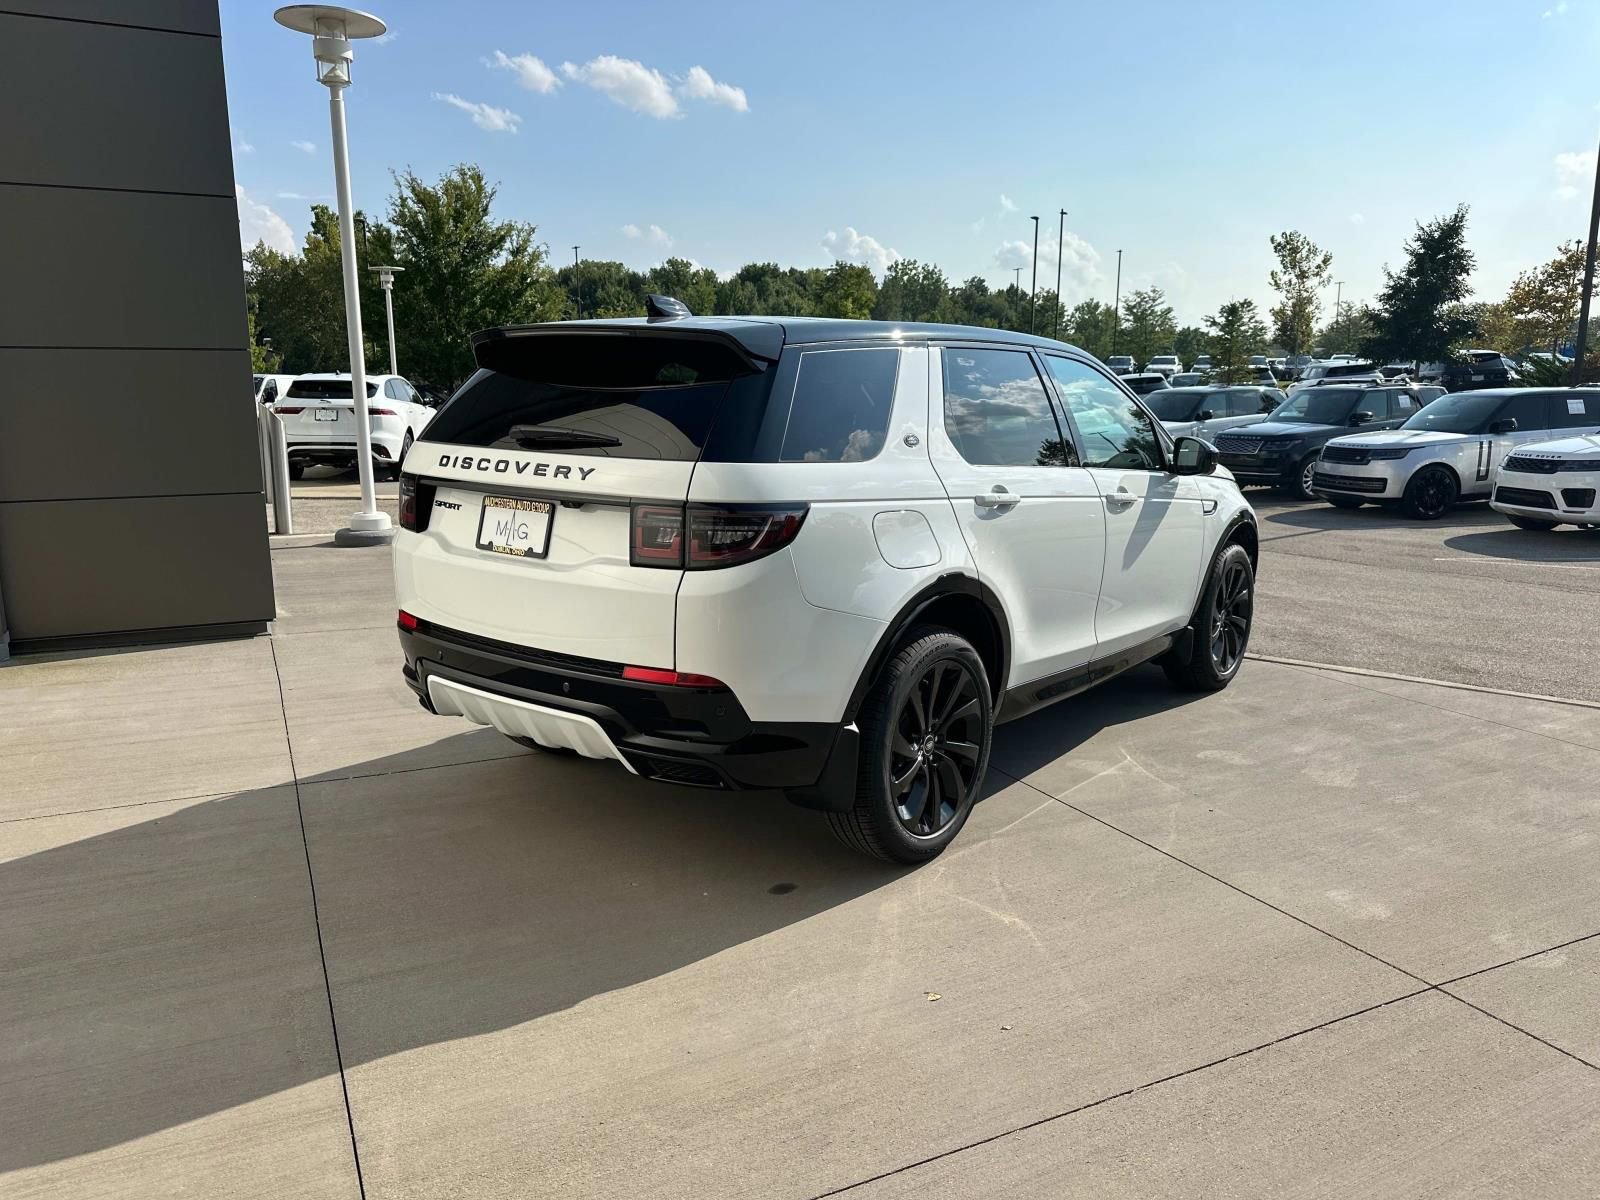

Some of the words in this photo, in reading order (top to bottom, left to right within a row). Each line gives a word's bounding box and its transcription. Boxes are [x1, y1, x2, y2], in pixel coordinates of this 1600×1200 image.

[439, 455, 595, 480] DISCOVERY
[434, 499, 462, 511] SPORT
[517, 500, 530, 511] AUTO
[531, 502, 550, 513] GROUP
